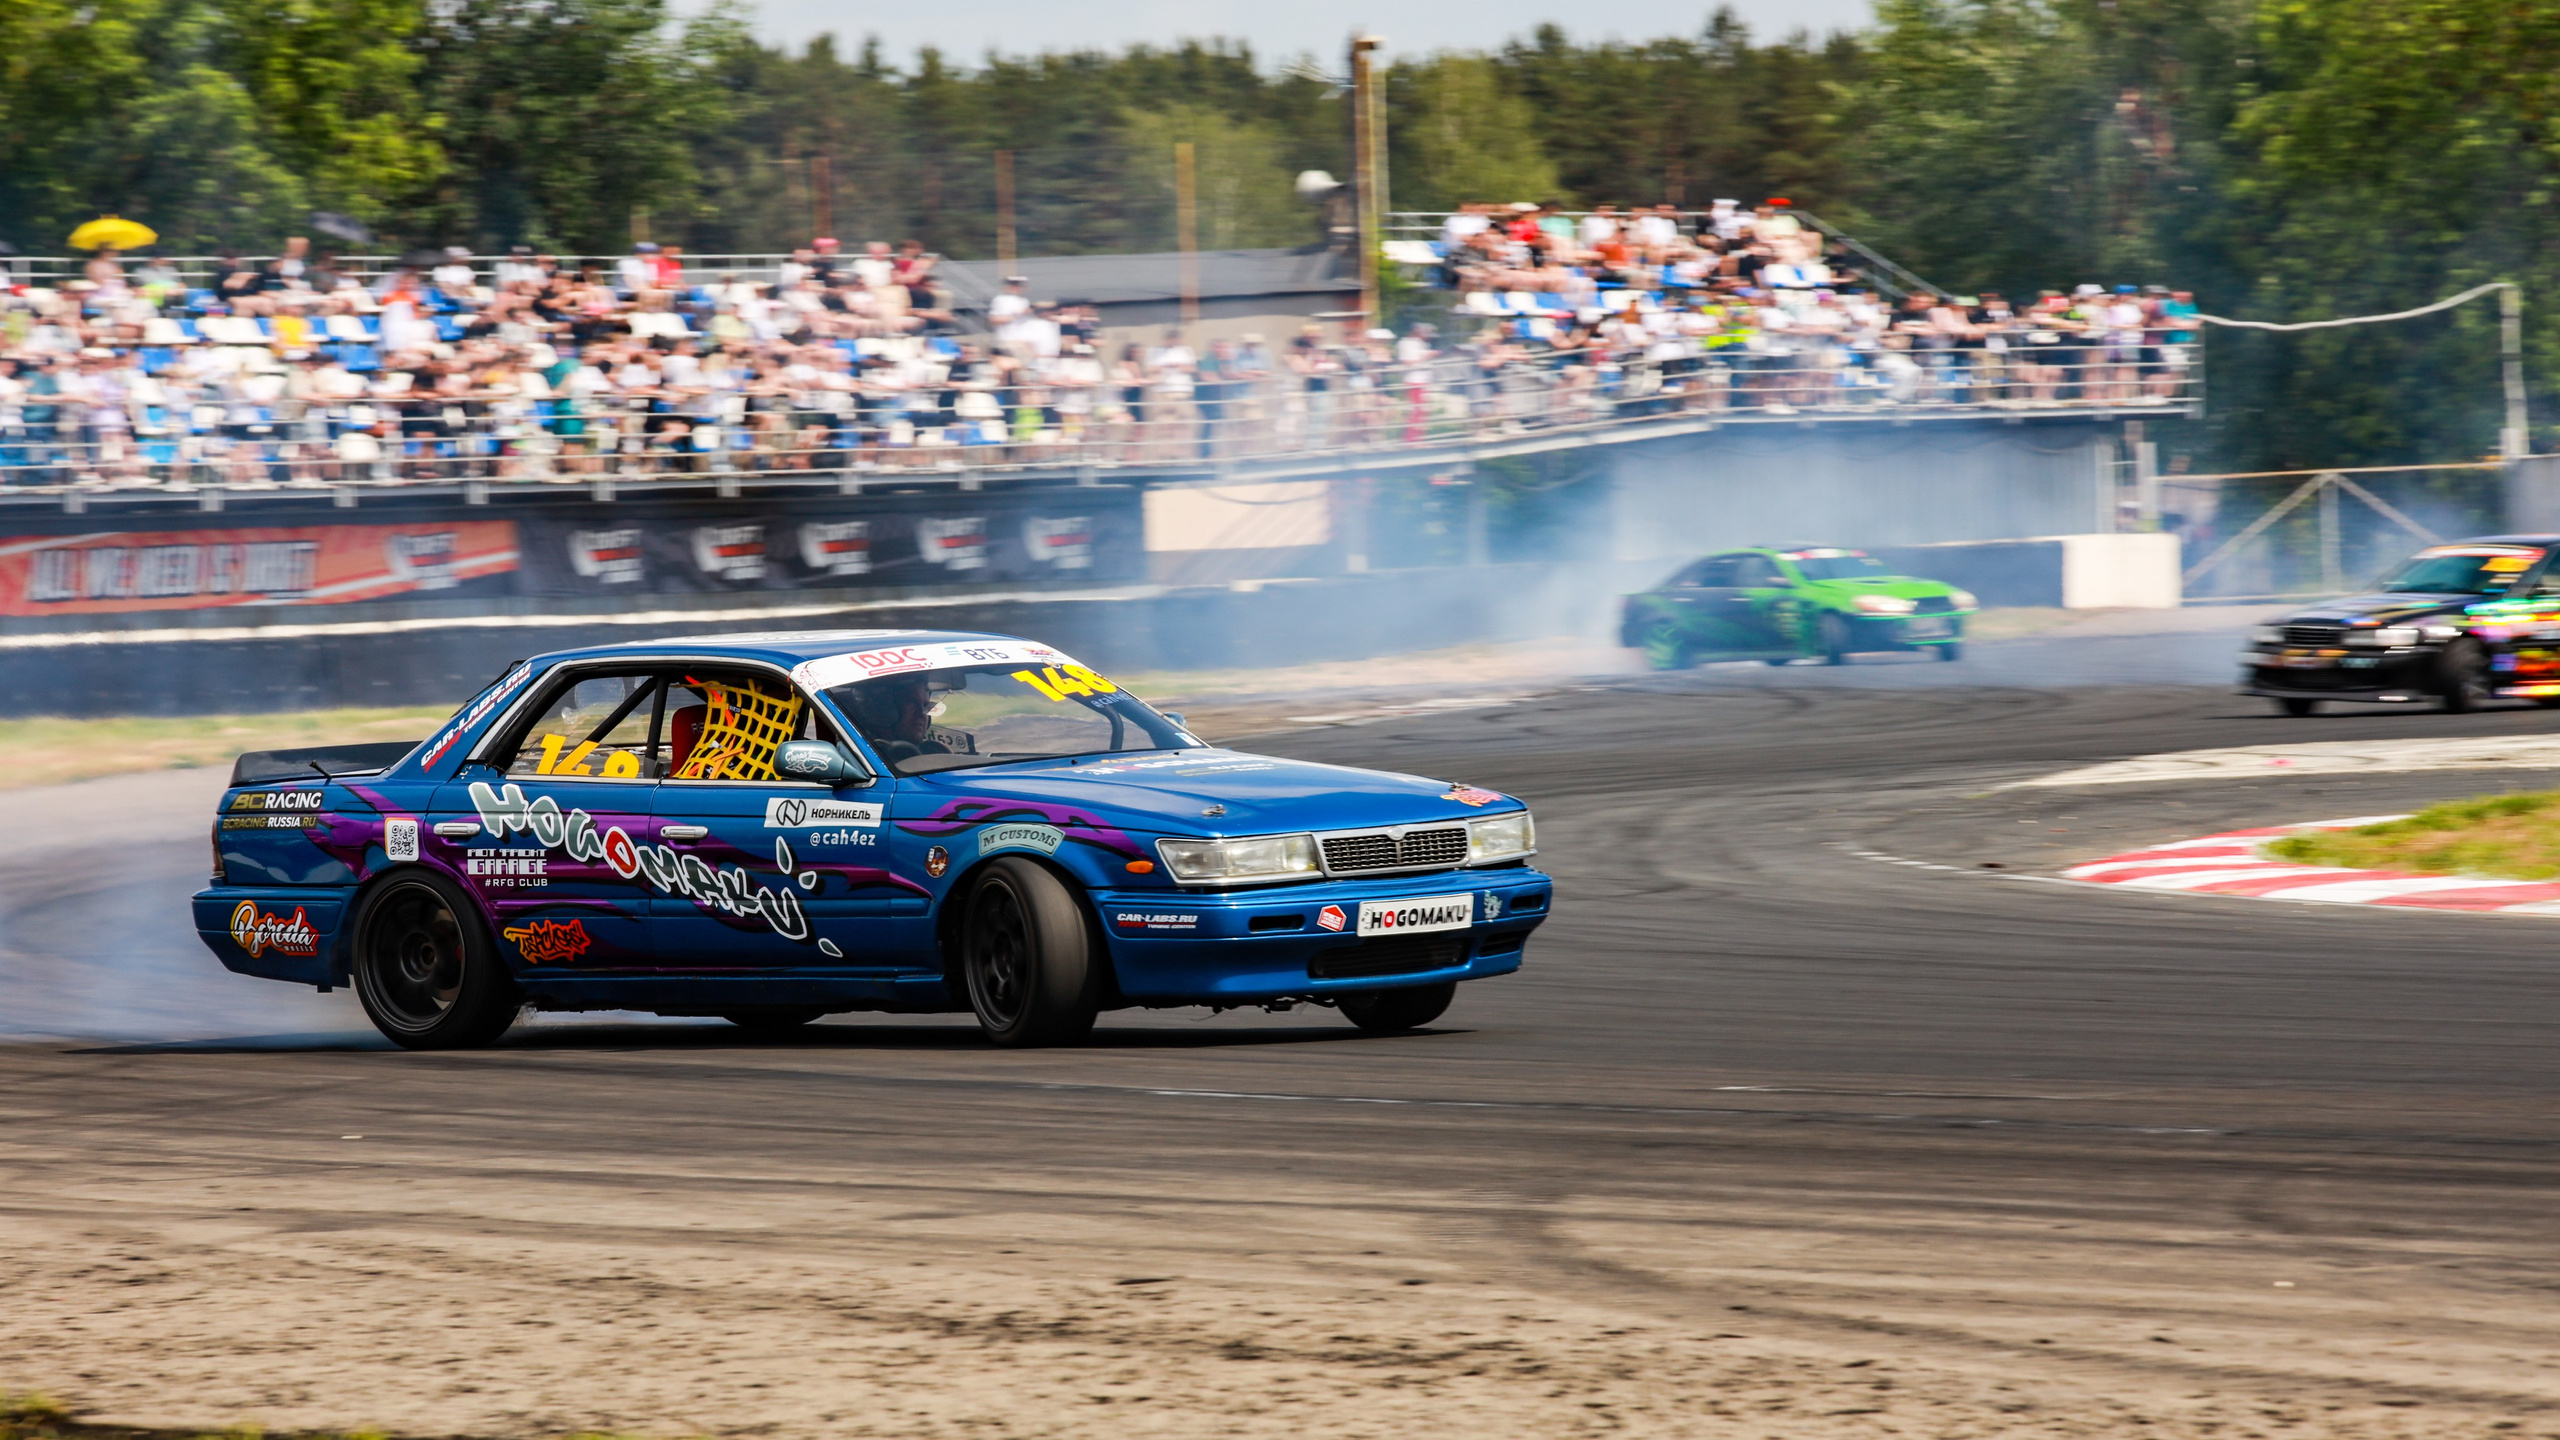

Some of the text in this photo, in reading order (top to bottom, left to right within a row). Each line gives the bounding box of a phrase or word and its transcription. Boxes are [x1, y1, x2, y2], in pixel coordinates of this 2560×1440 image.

[962, 648, 1010, 661] ВТБ
[496, 671, 531, 704] CENTER
[1010, 663, 1118, 702] 148
[420, 662, 532, 767] CAR-LABS.RU
[811, 808, 871, 820] НОРНИКЕЛЬ
[810, 828, 876, 846] @cah4ez
[983, 828, 1058, 848] M CUSTOMS
[467, 858, 548, 875] GARAGE
[484, 878, 548, 887] #RFG CLUB
[1116, 913, 1199, 923] CAR-LABS.RU
[1370, 904, 1468, 930] HOGOMAKU
